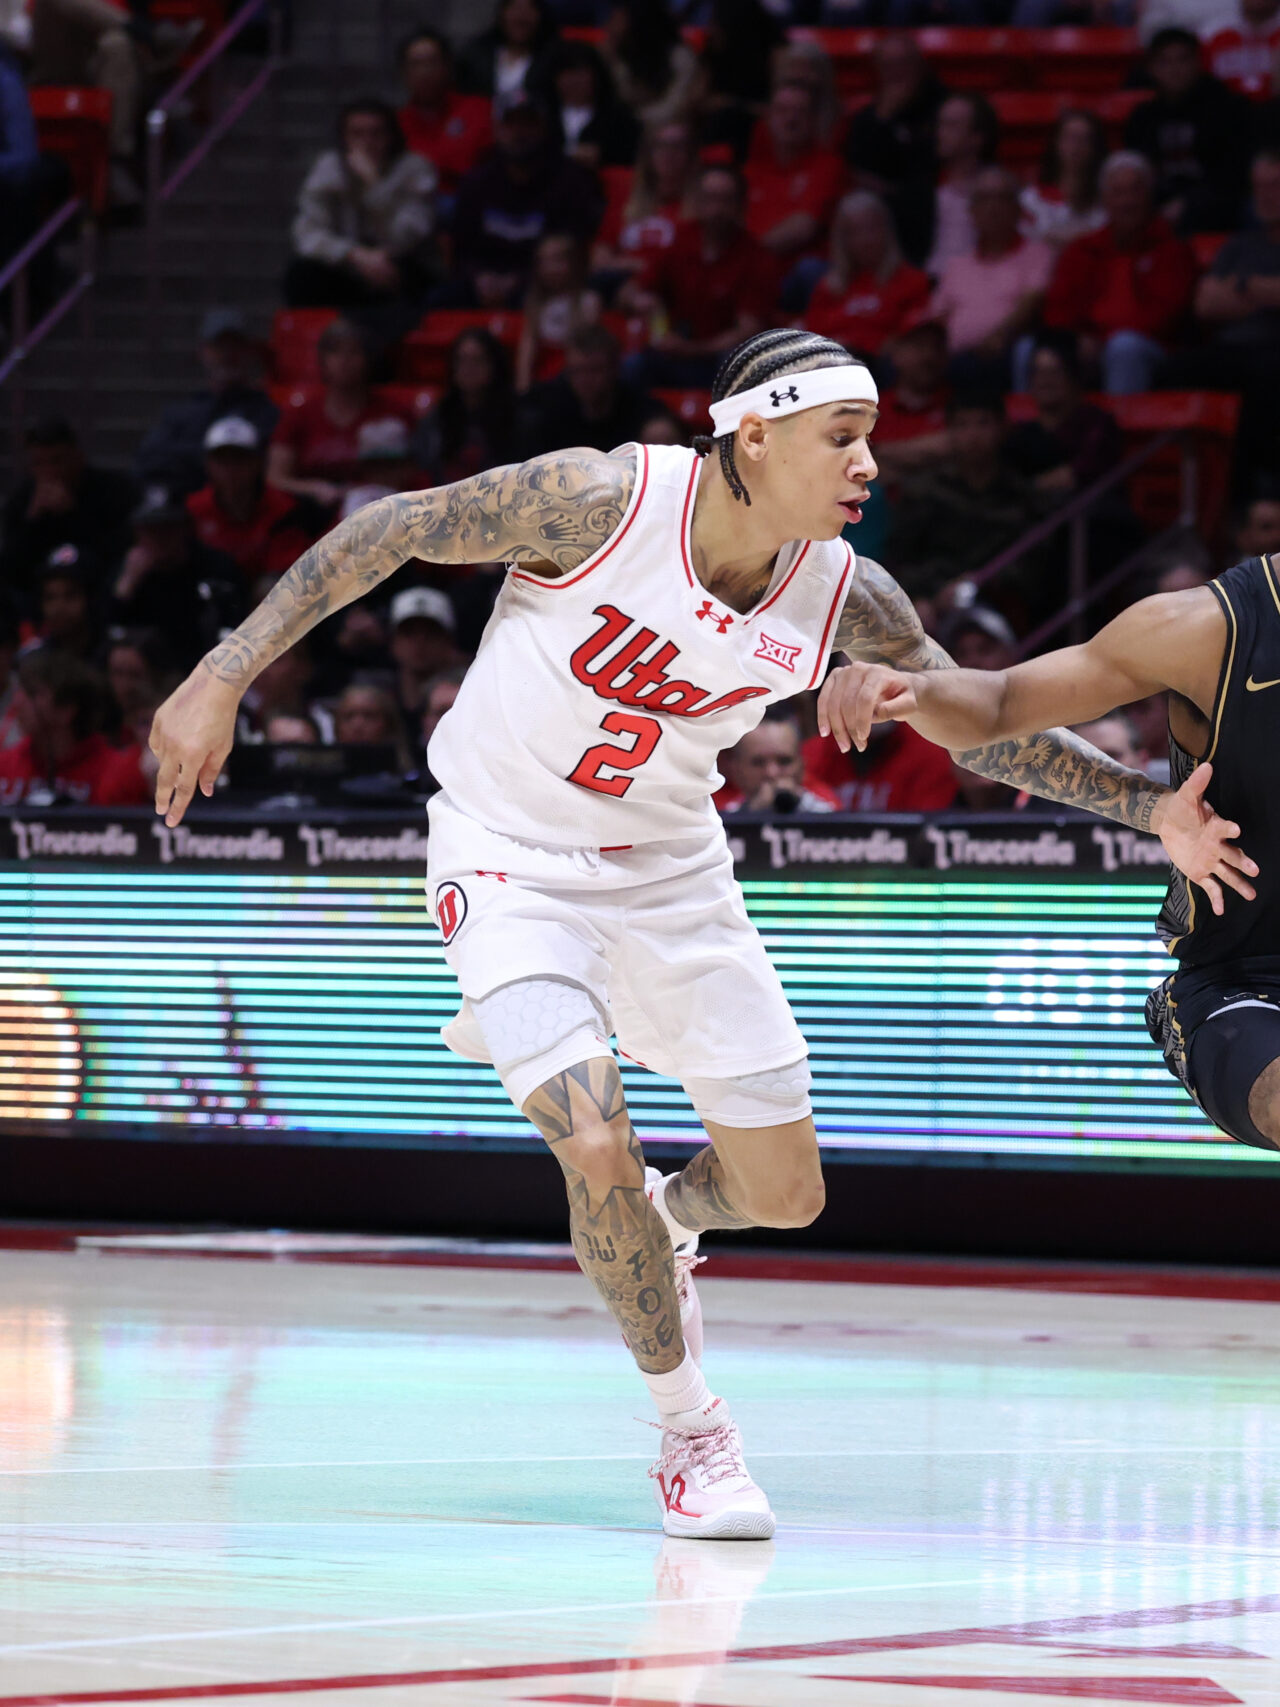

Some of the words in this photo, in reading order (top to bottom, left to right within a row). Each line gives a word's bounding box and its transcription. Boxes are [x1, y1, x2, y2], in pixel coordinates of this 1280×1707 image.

[565, 711, 663, 798] 2
[30, 824, 138, 857] Trucordia
[173, 826, 284, 860] Trucordia
[786, 827, 907, 864] Trucordia
[949, 829, 1075, 866] Trucordia
